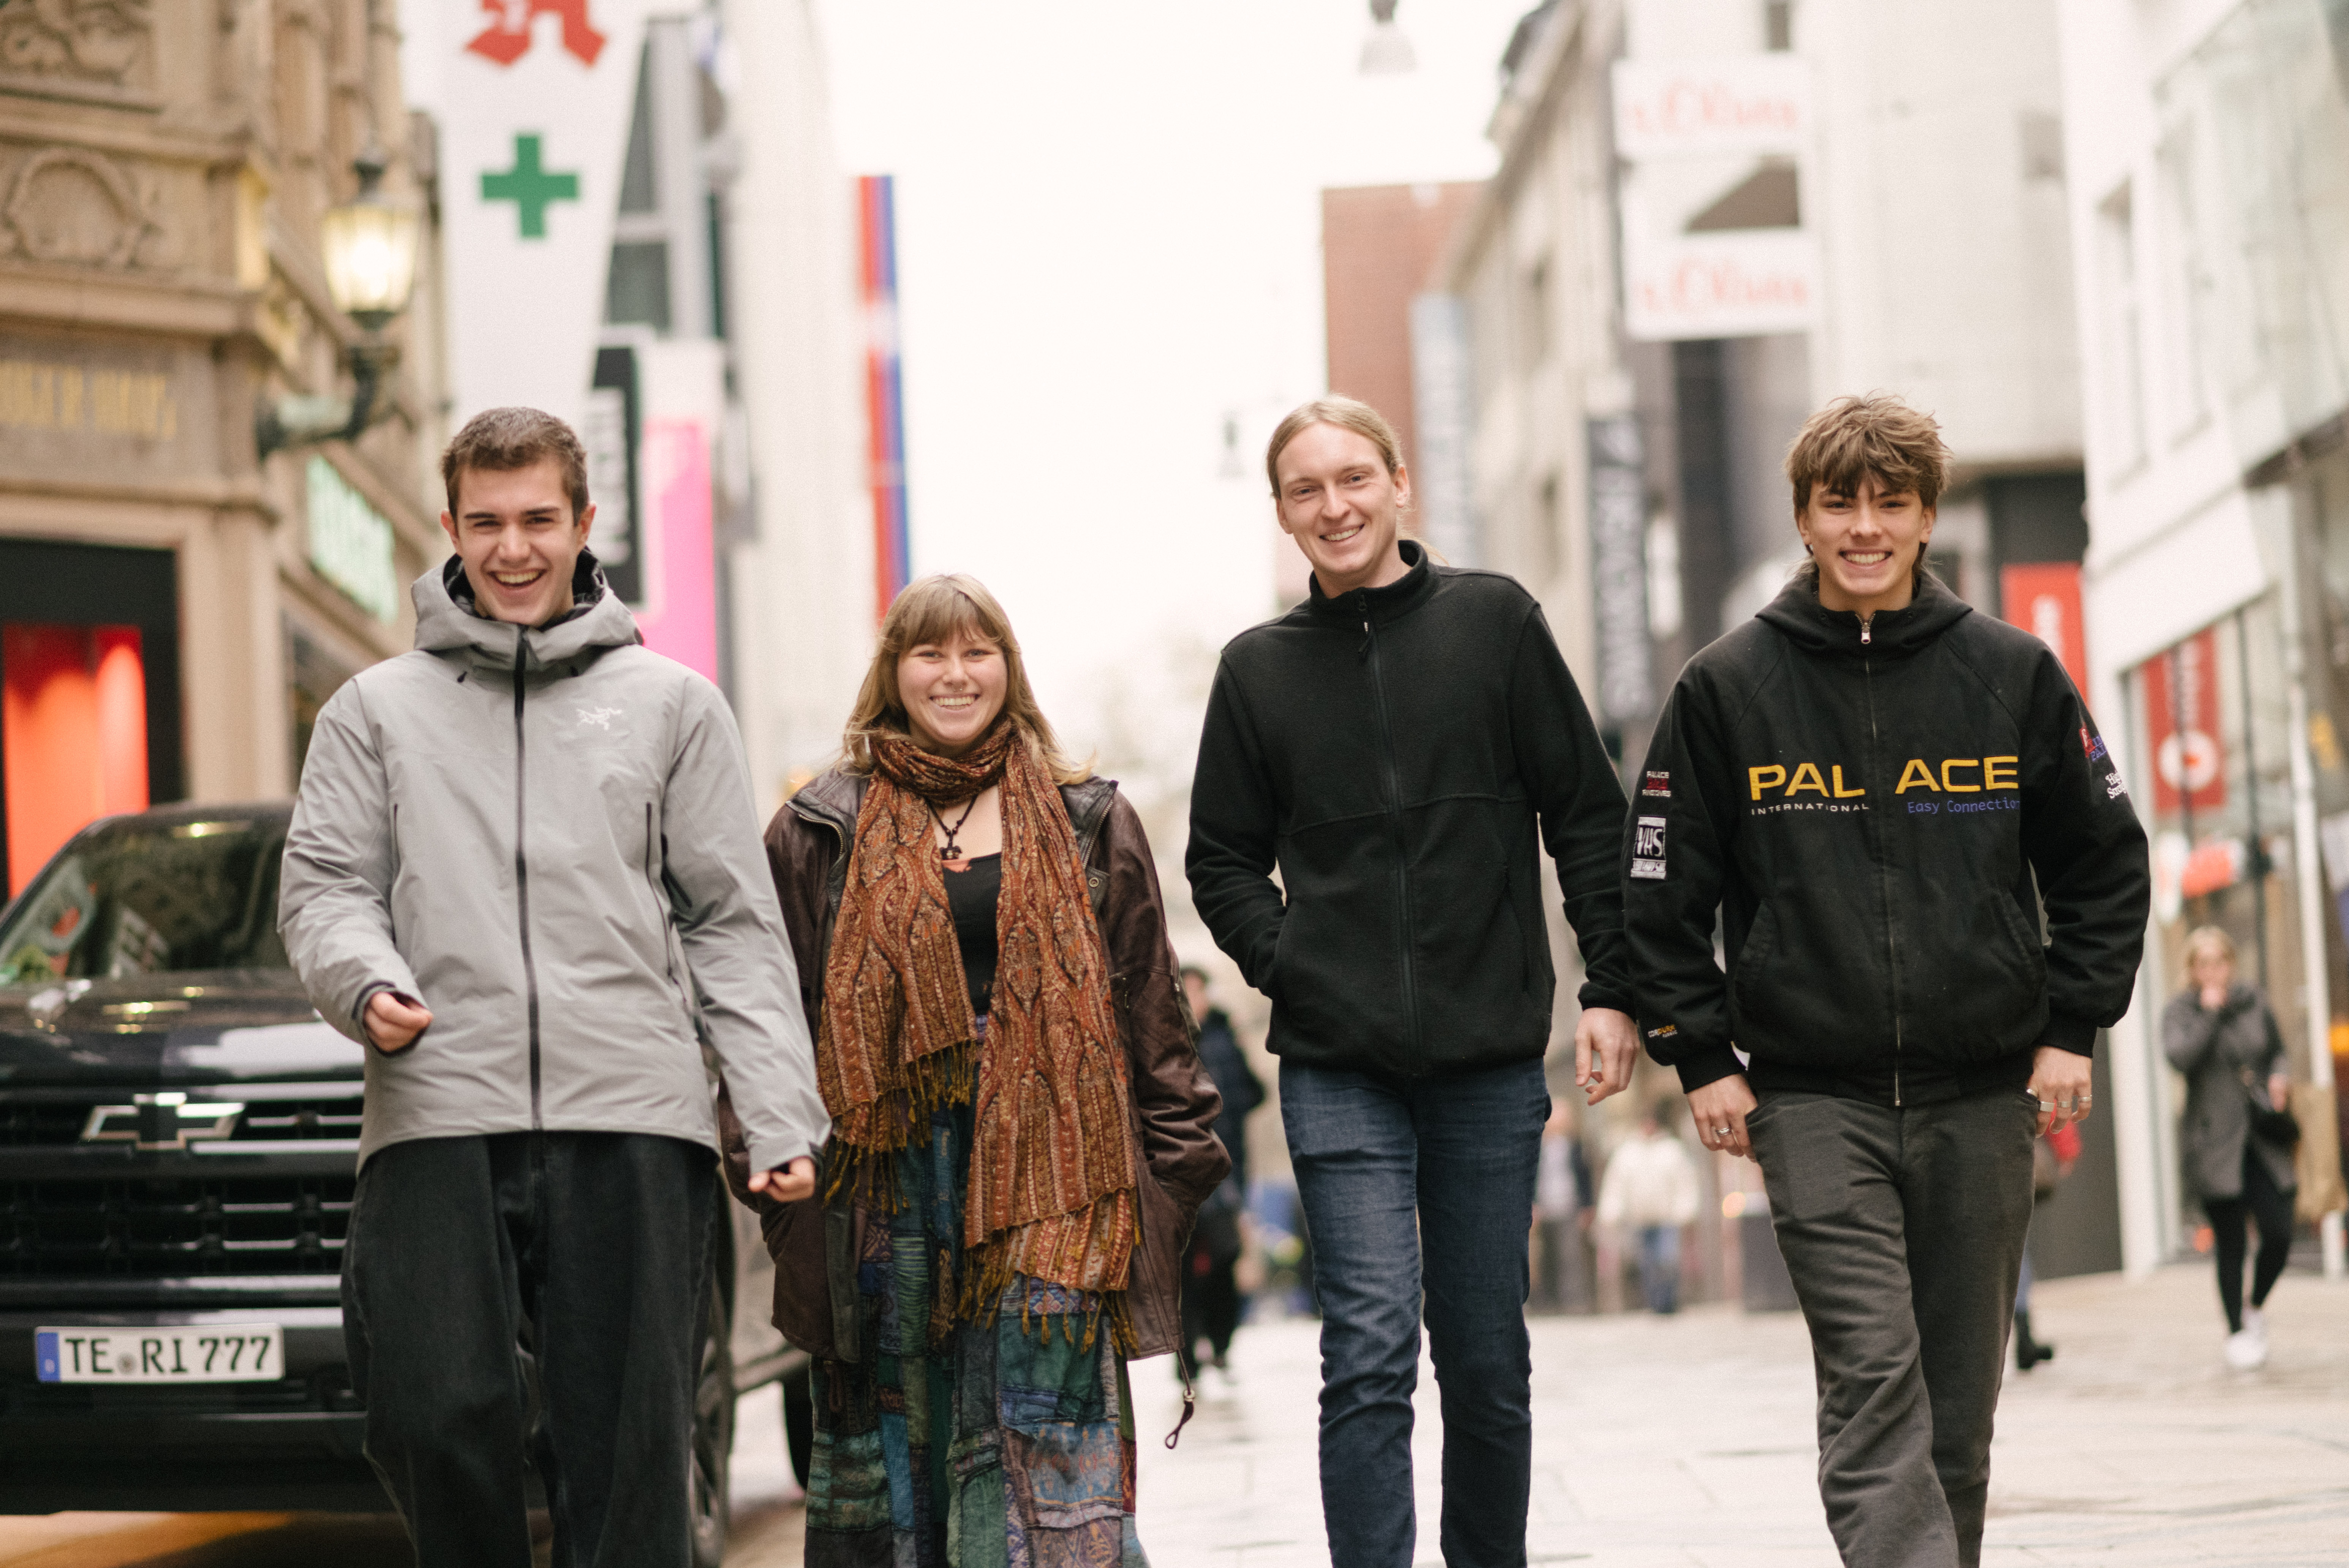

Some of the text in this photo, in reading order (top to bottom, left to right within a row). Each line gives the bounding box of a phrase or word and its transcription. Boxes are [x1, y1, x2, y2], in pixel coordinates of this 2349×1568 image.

[1748, 756, 2019, 800] PAL ACE
[1751, 803, 1870, 815] INTERNATIONAL
[1907, 802, 1940, 814] Easy
[1637, 827, 1663, 857] VHS
[65, 1338, 114, 1374] TE
